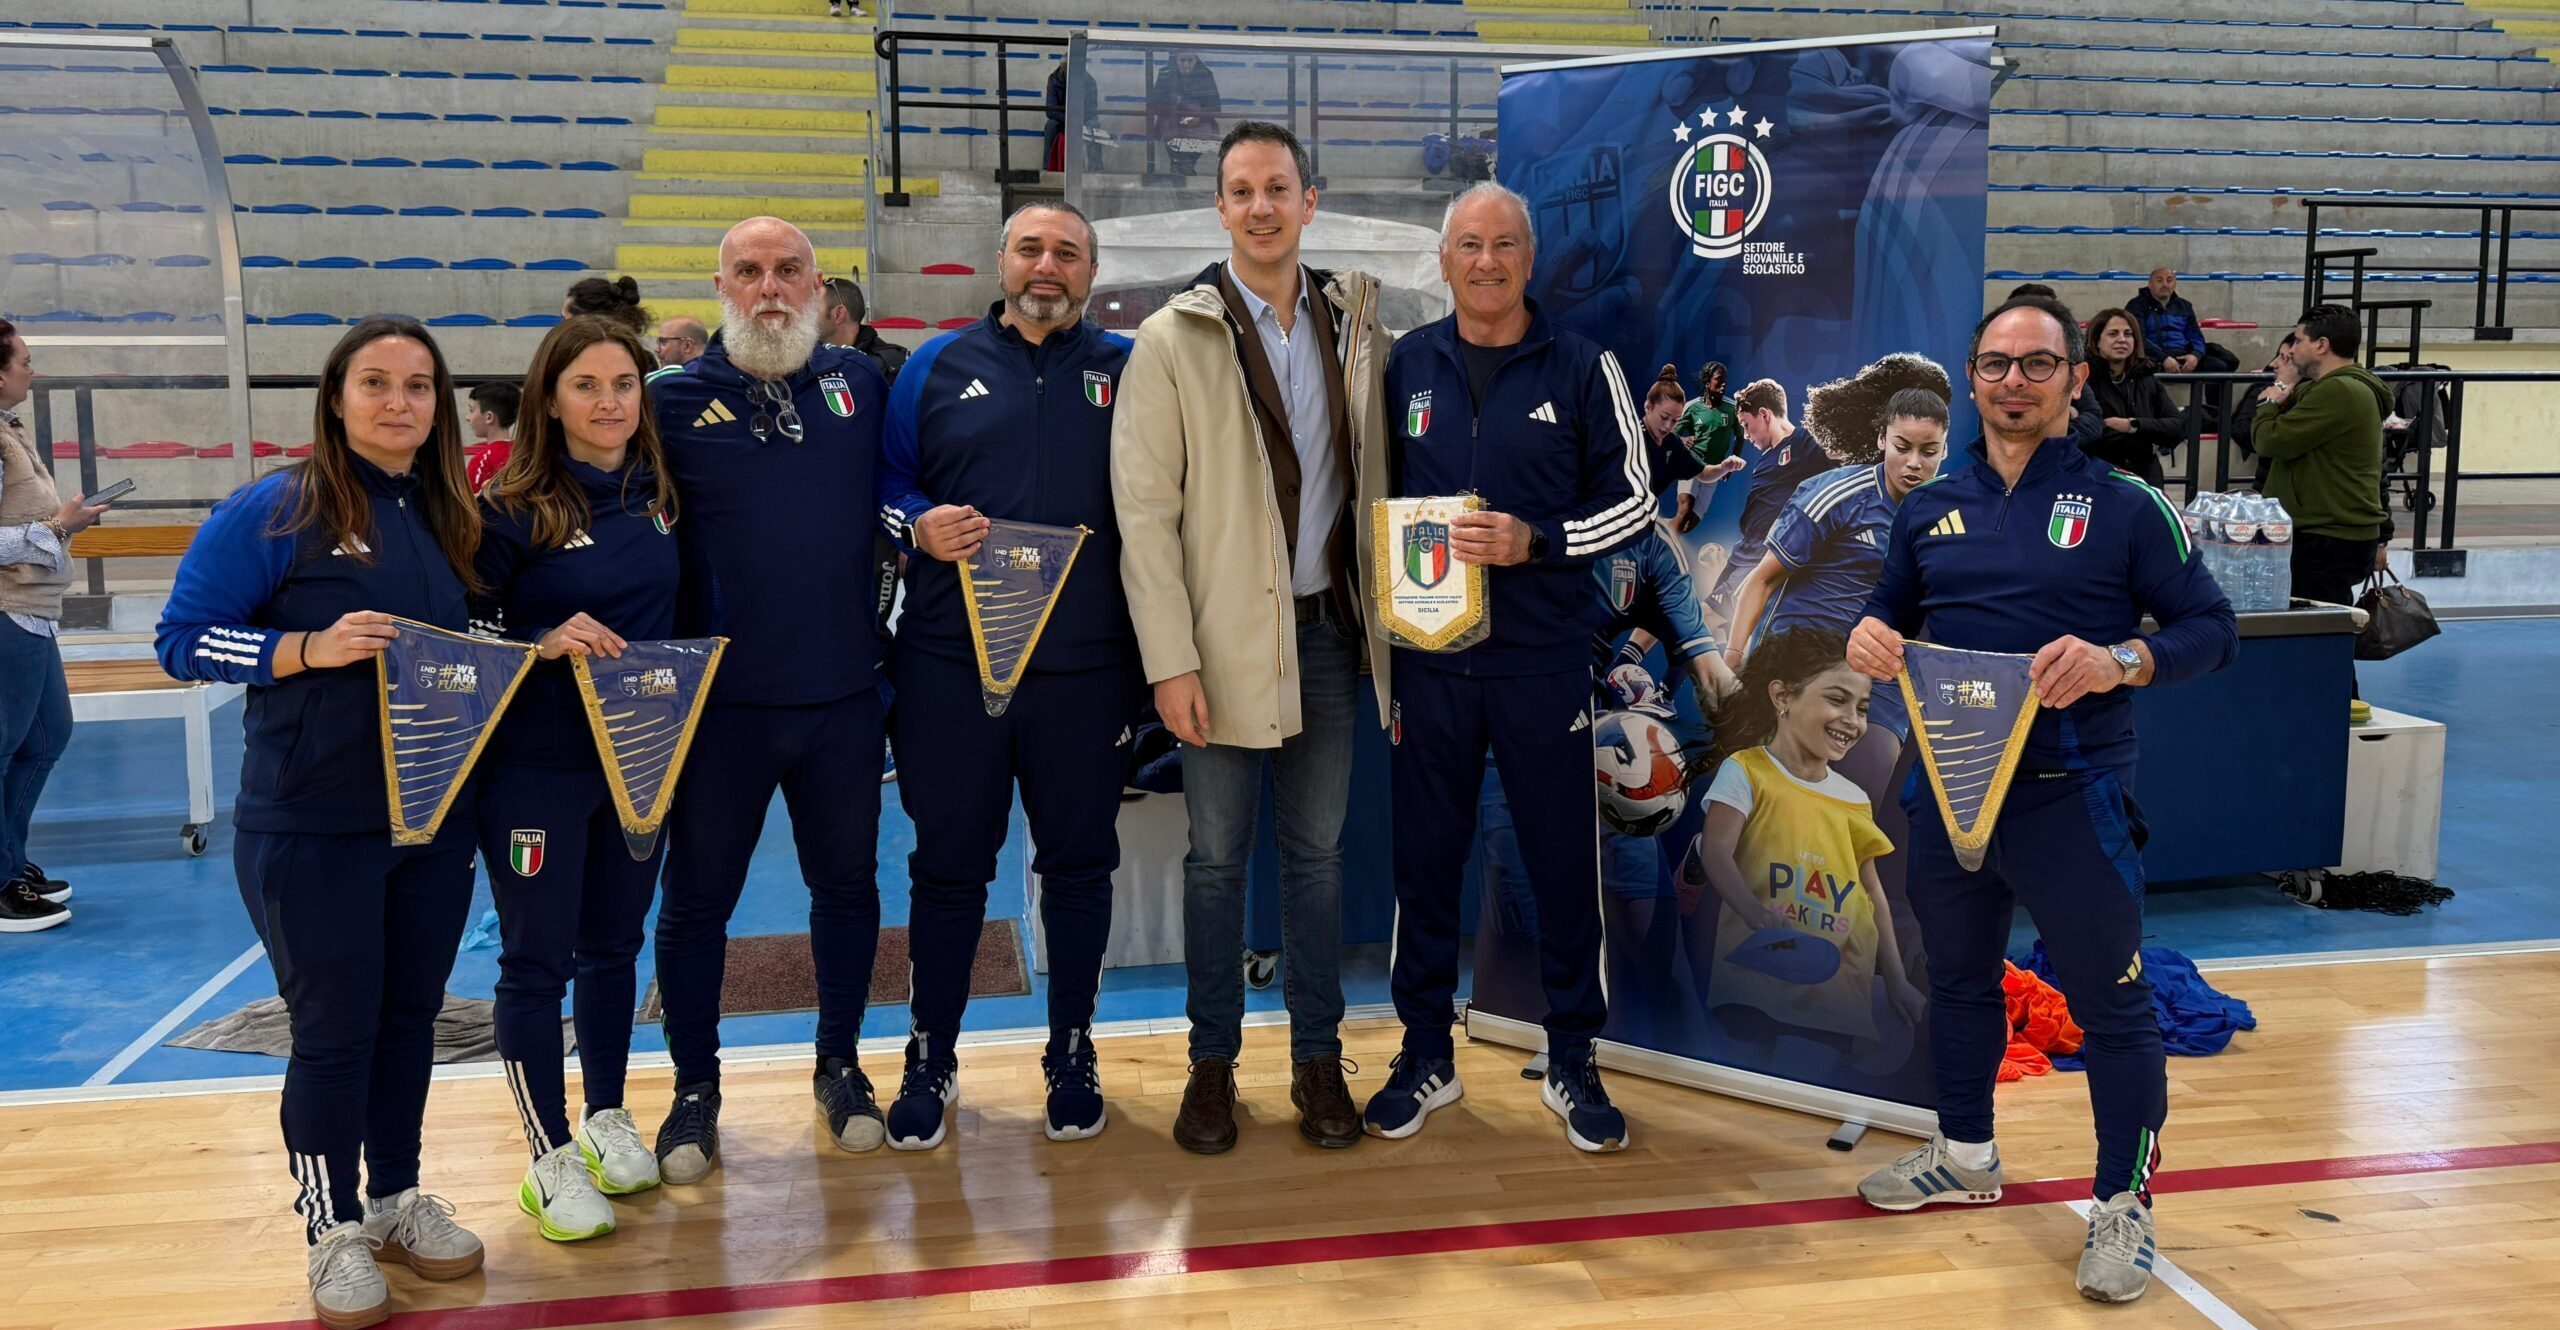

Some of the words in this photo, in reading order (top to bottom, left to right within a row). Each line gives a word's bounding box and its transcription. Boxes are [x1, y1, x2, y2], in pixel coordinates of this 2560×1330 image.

[1695, 172, 1745, 198] FIGC
[1709, 199, 1729, 207] ITALIA
[1743, 242, 1785, 253] SETTORE
[1743, 253, 1794, 264] GIOVANILE
[1797, 253, 1804, 263] E
[1742, 263, 1805, 275] SCOLASTICO
[1086, 373, 1109, 383] ITALIA
[822, 381, 846, 390] ITALIA
[2056, 504, 2087, 516] ITALIA
[1406, 526, 1446, 537] ITALIA
[420, 665, 437, 673] LND
[453, 674, 477, 683] ARE
[653, 677, 676, 685] ARE
[1971, 690, 1996, 699] ARE
[513, 833, 542, 843] ITALIA
[1769, 862, 1857, 914] PLAY
